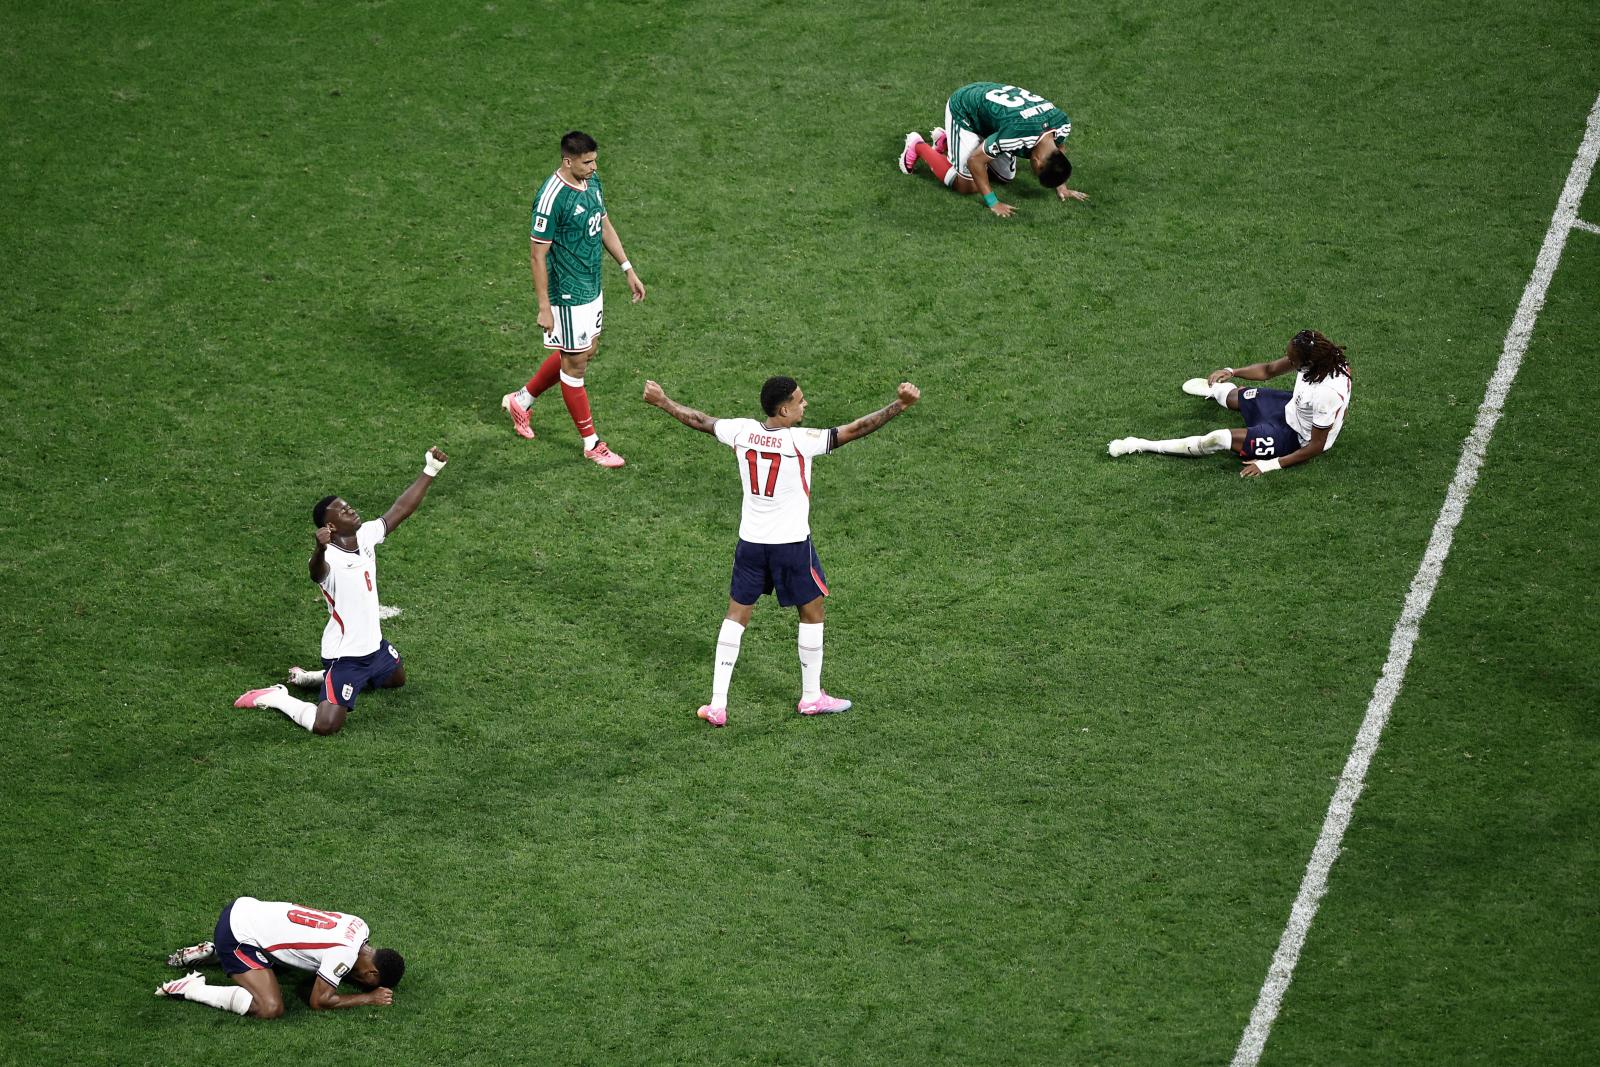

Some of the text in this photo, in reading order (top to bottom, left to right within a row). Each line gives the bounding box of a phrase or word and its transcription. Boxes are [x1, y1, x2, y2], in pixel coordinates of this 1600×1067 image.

[588, 211, 601, 237] 22
[748, 433, 782, 448] ROGERS
[1255, 436, 1275, 456] 25
[745, 448, 781, 497] 17
[364, 570, 373, 592] 6
[387, 644, 399, 659] 6
